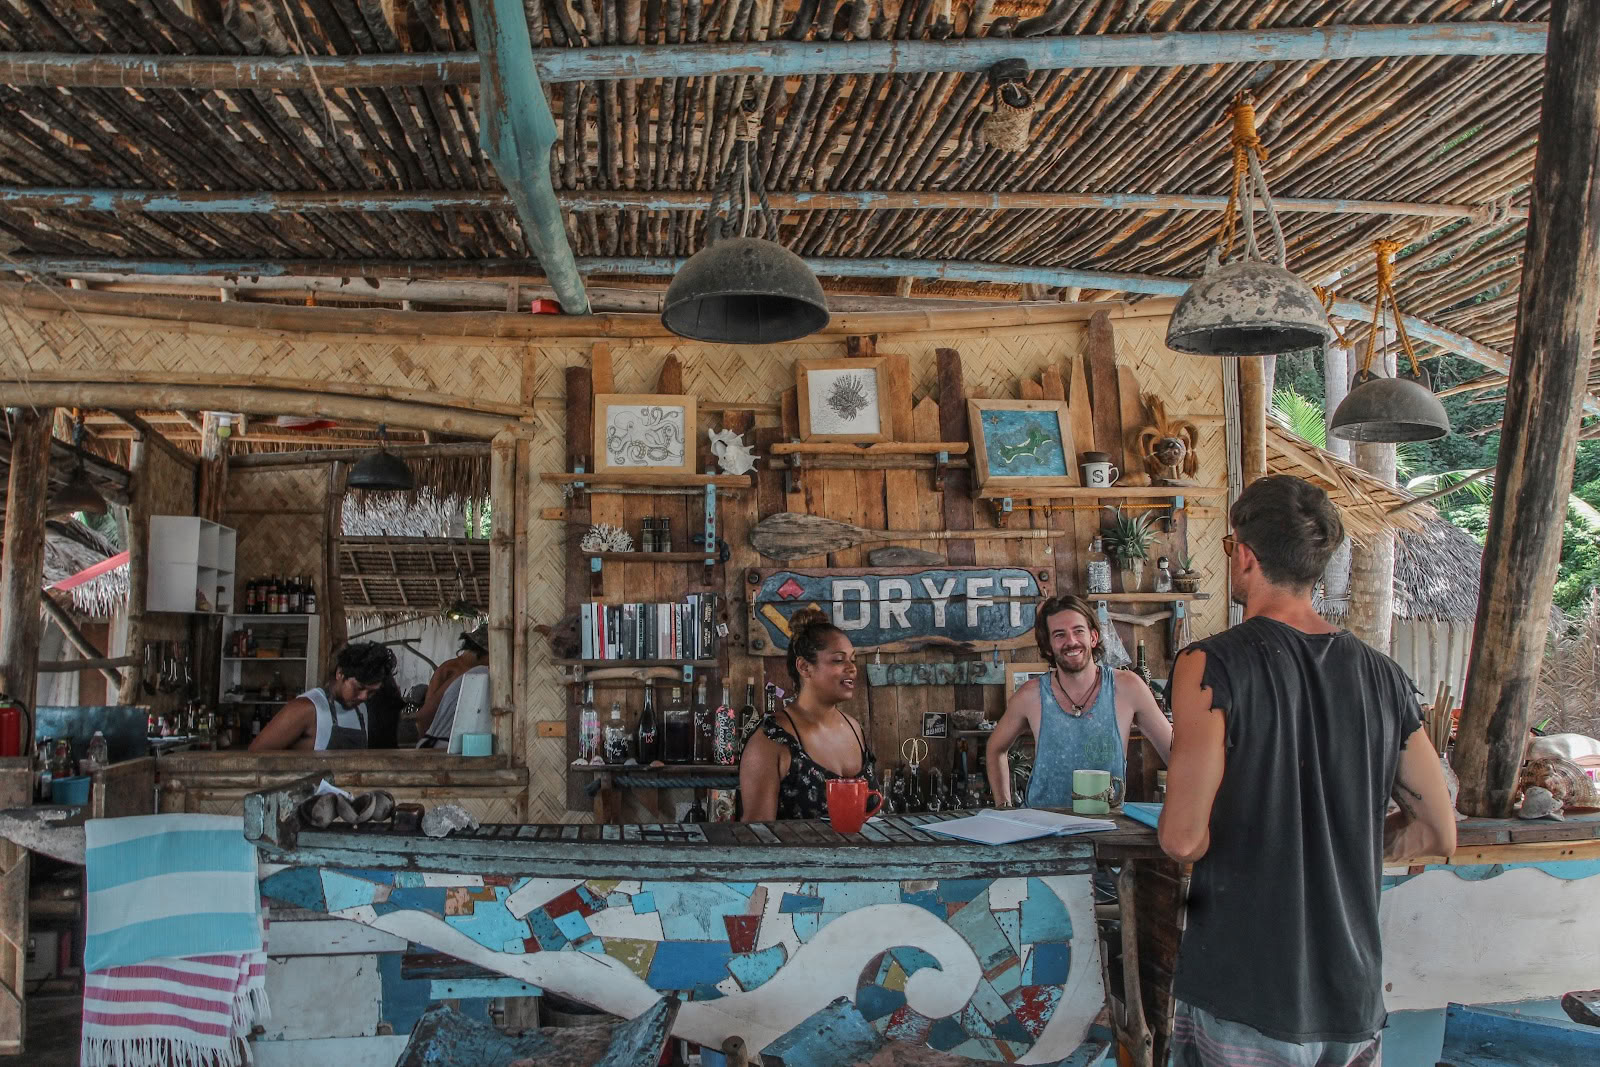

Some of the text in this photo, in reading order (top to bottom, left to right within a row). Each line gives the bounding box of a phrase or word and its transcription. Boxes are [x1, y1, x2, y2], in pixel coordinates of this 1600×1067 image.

[1092, 469, 1104, 484] S
[831, 576, 1029, 631] DRYFT
[886, 661, 988, 687] CAMP
